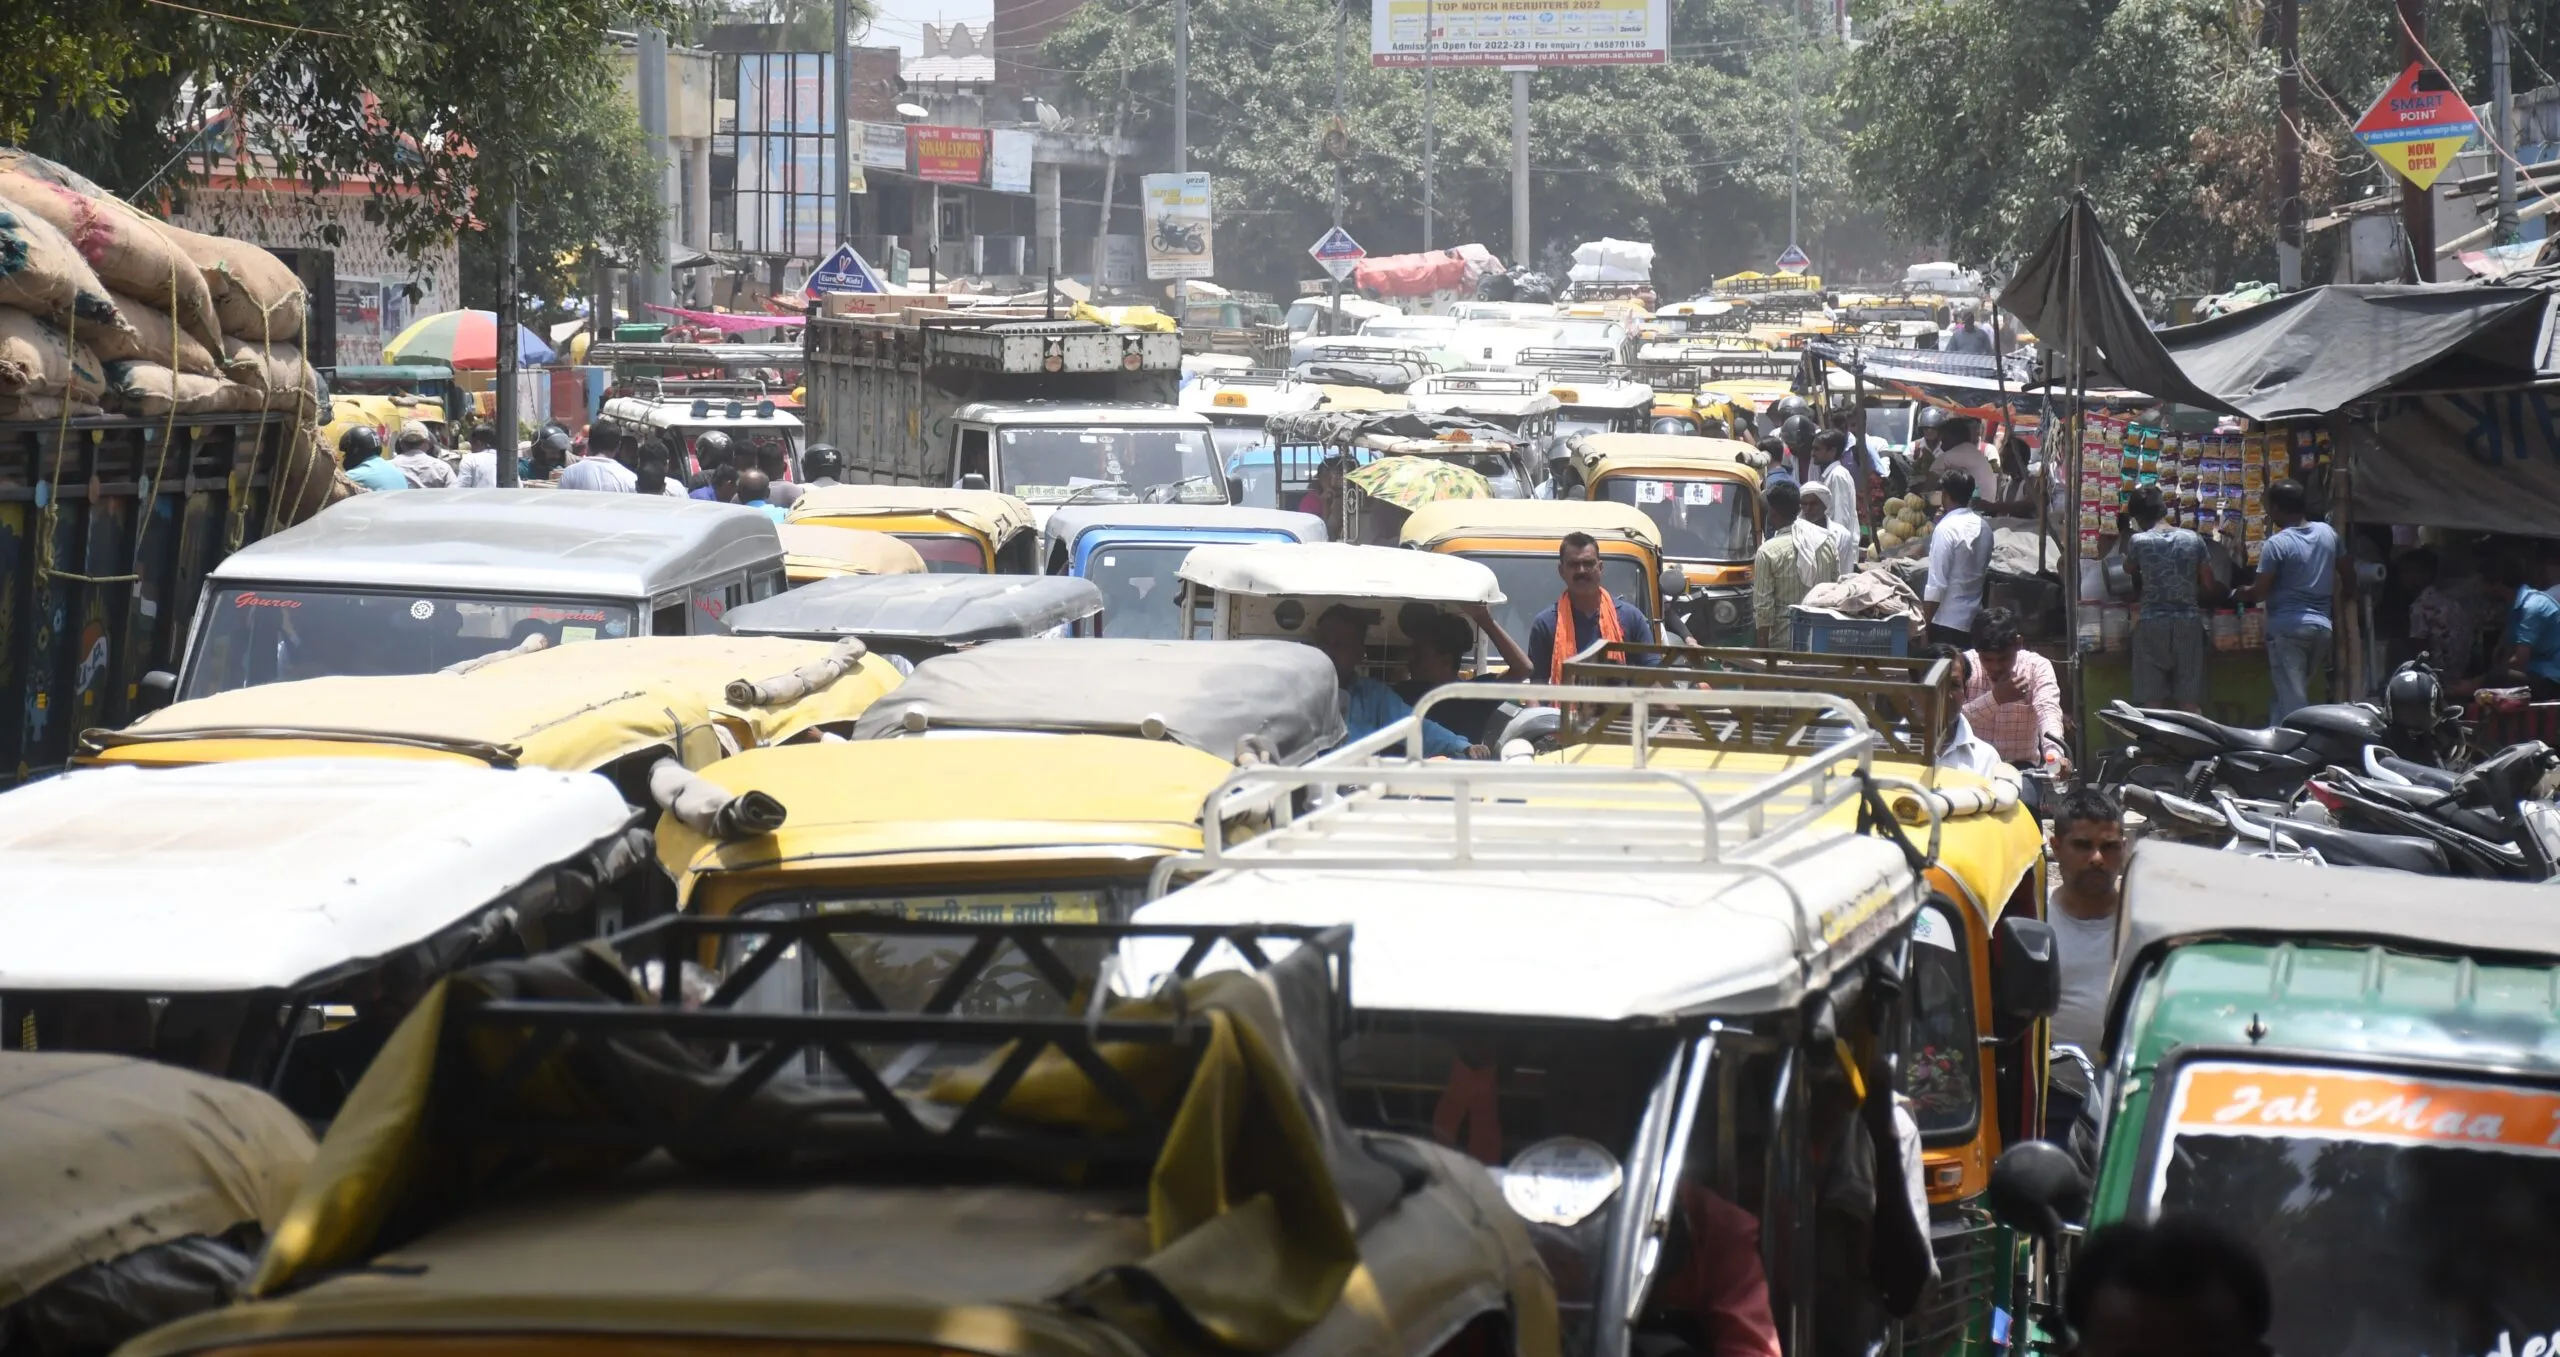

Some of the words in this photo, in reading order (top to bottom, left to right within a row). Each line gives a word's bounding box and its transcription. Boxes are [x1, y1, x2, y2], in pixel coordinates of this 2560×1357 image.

[1437, 3, 1458, 11] TOP
[1462, 2, 1498, 11] NOTCH
[1502, 1, 1569, 10] RECRUITERS
[1574, 0, 1601, 9] 2022
[1392, 42, 1439, 51] Admissn
[1442, 42, 1466, 51] Open
[1469, 41, 1481, 50] for
[1485, 41, 1525, 50] 2022-23
[1551, 41, 1580, 51] enquiry
[2390, 95, 2444, 111] SMART
[2400, 110, 2437, 121] POINT
[2407, 143, 2435, 157] NOW
[2408, 157, 2437, 171] OPEN
[2213, 1086, 2322, 1123] Jai
[2342, 1096, 2505, 1140] Maa
